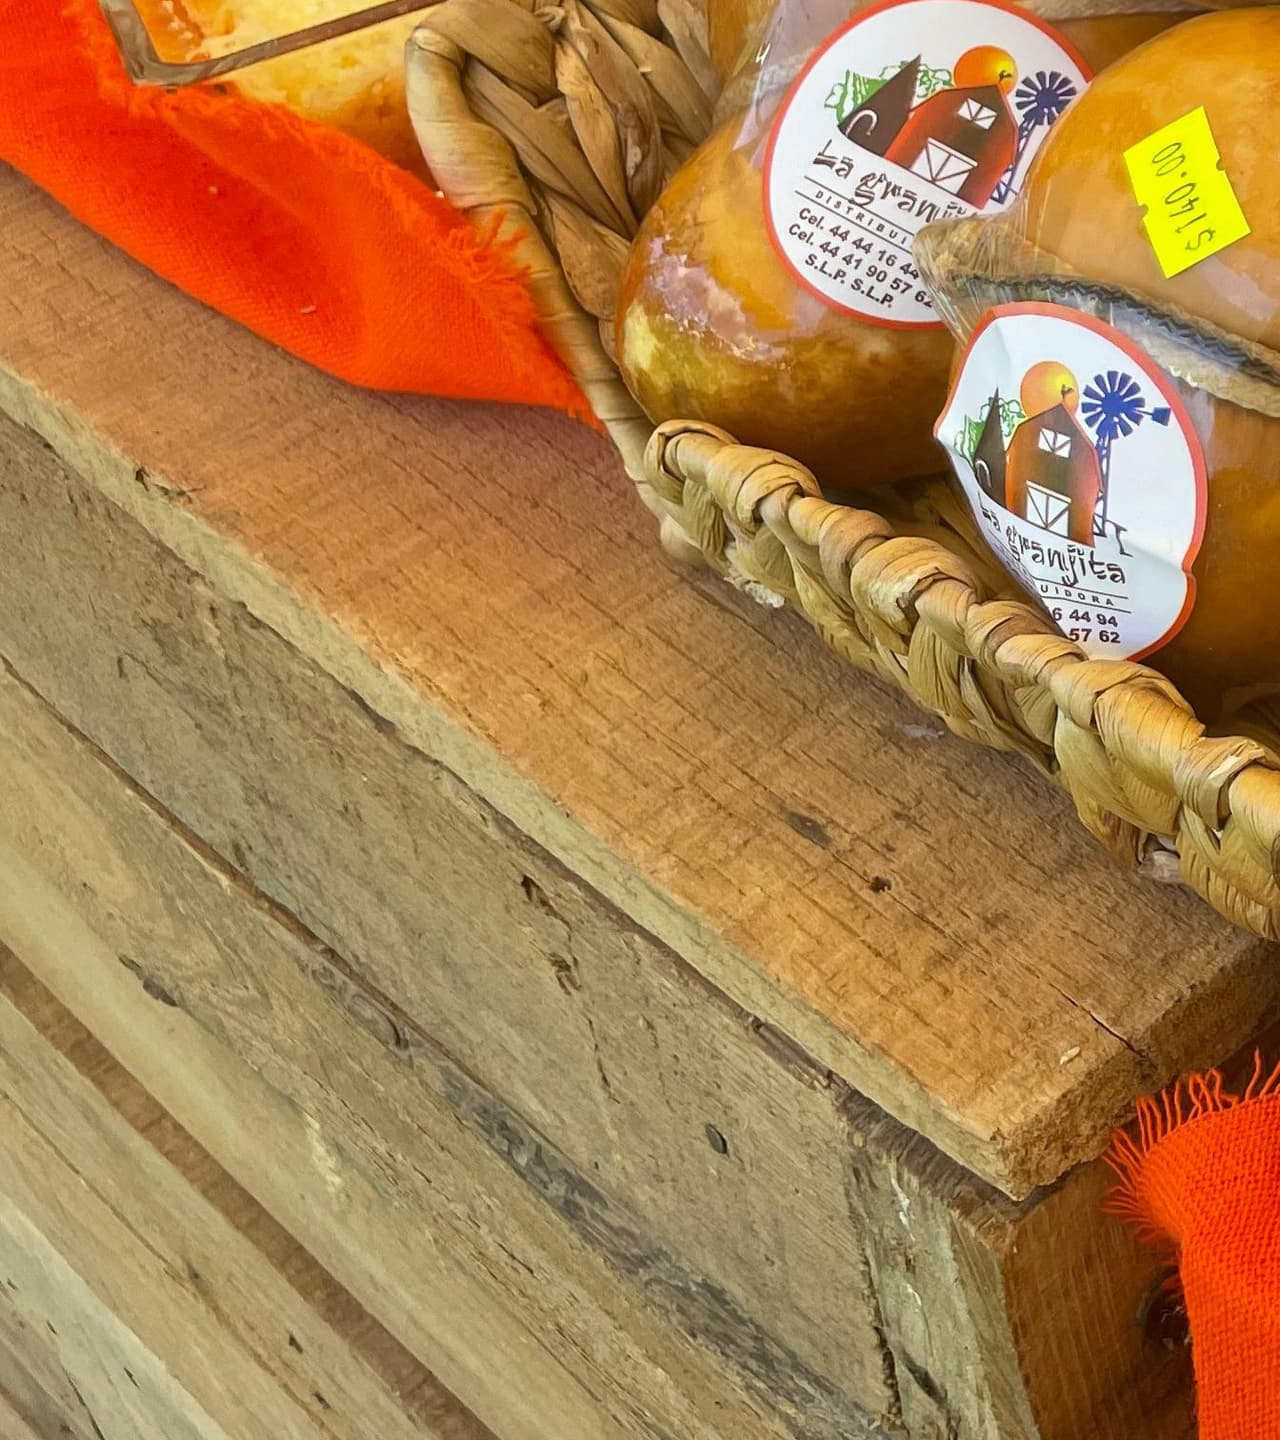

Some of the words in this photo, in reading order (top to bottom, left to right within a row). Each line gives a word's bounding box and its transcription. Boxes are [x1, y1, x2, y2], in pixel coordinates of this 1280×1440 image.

[812, 139, 854, 179] La
[1152, 142, 1216, 250] $140.00
[789, 224, 814, 246] Cel.
[819, 241, 840, 258] 44
[842, 253, 863, 270] 41
[866, 266, 887, 282] 90
[890, 278, 913, 294] 57
[799, 208, 823, 230] Cel.
[830, 225, 850, 241] 44
[852, 238, 873, 254] 44
[878, 250, 897, 266] 16
[805, 253, 846, 284] S.L.P.
[851, 279, 893, 308] S.L.P.
[1069, 609, 1091, 622] 44
[1097, 612, 1118, 627] 94
[1069, 629, 1092, 641] 57
[1099, 630, 1121, 643] 62
